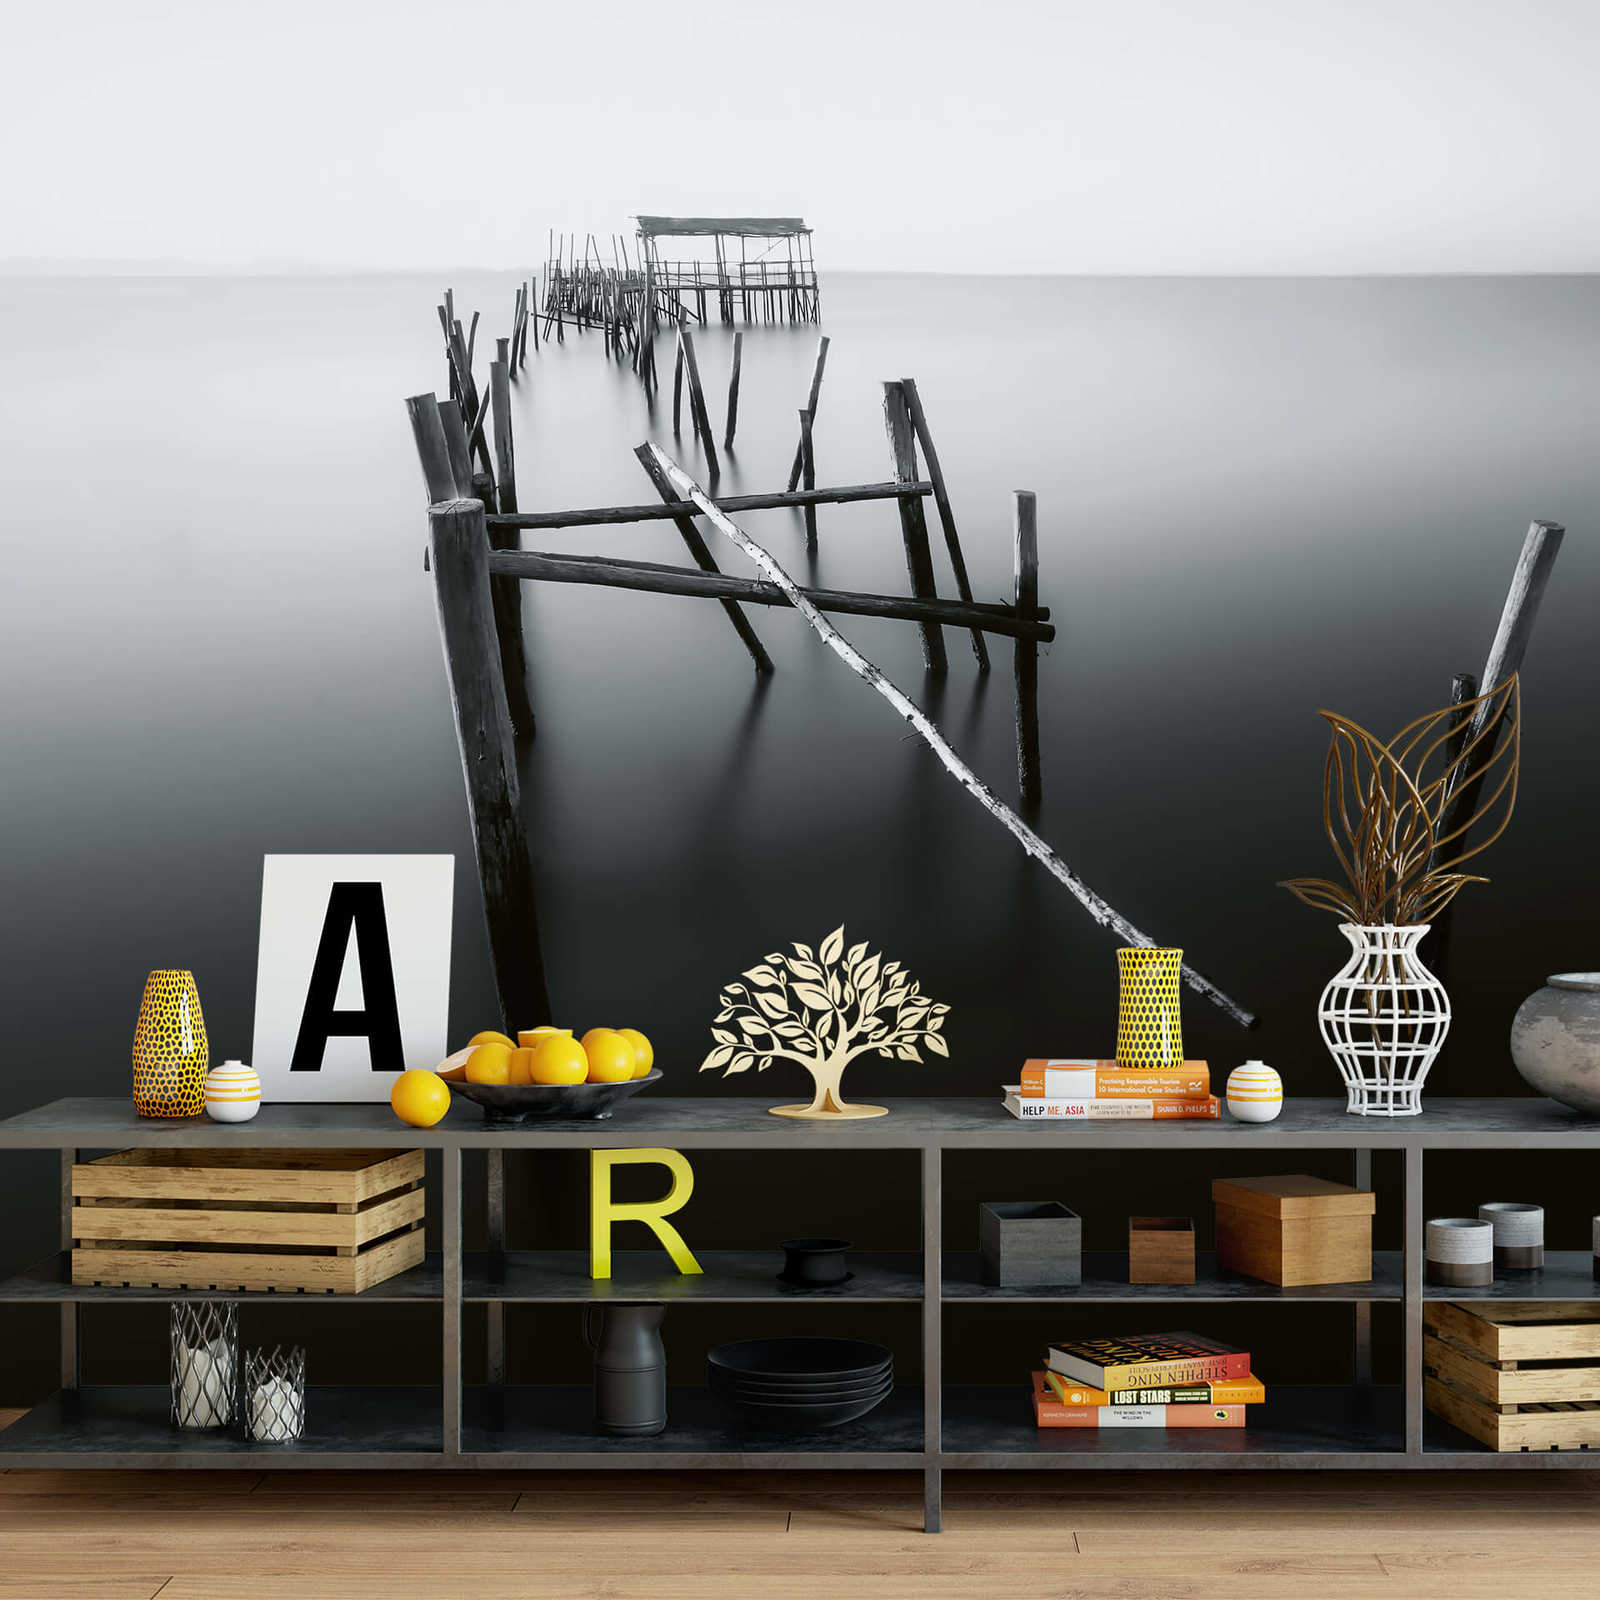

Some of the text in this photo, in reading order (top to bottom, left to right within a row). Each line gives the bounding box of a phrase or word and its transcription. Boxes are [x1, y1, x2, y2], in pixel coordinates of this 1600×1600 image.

[290, 881, 406, 1072] A
[1107, 1086, 1146, 1094] International
[1022, 1105, 1045, 1116] HELP
[1047, 1105, 1063, 1117] ME,
[1065, 1105, 1085, 1115] ASIA
[590, 1148, 704, 1279] R
[1128, 1366, 1228, 1387] STEPHEN KING
[1114, 1391, 1138, 1404] LOST
[1140, 1390, 1171, 1404] STARS
